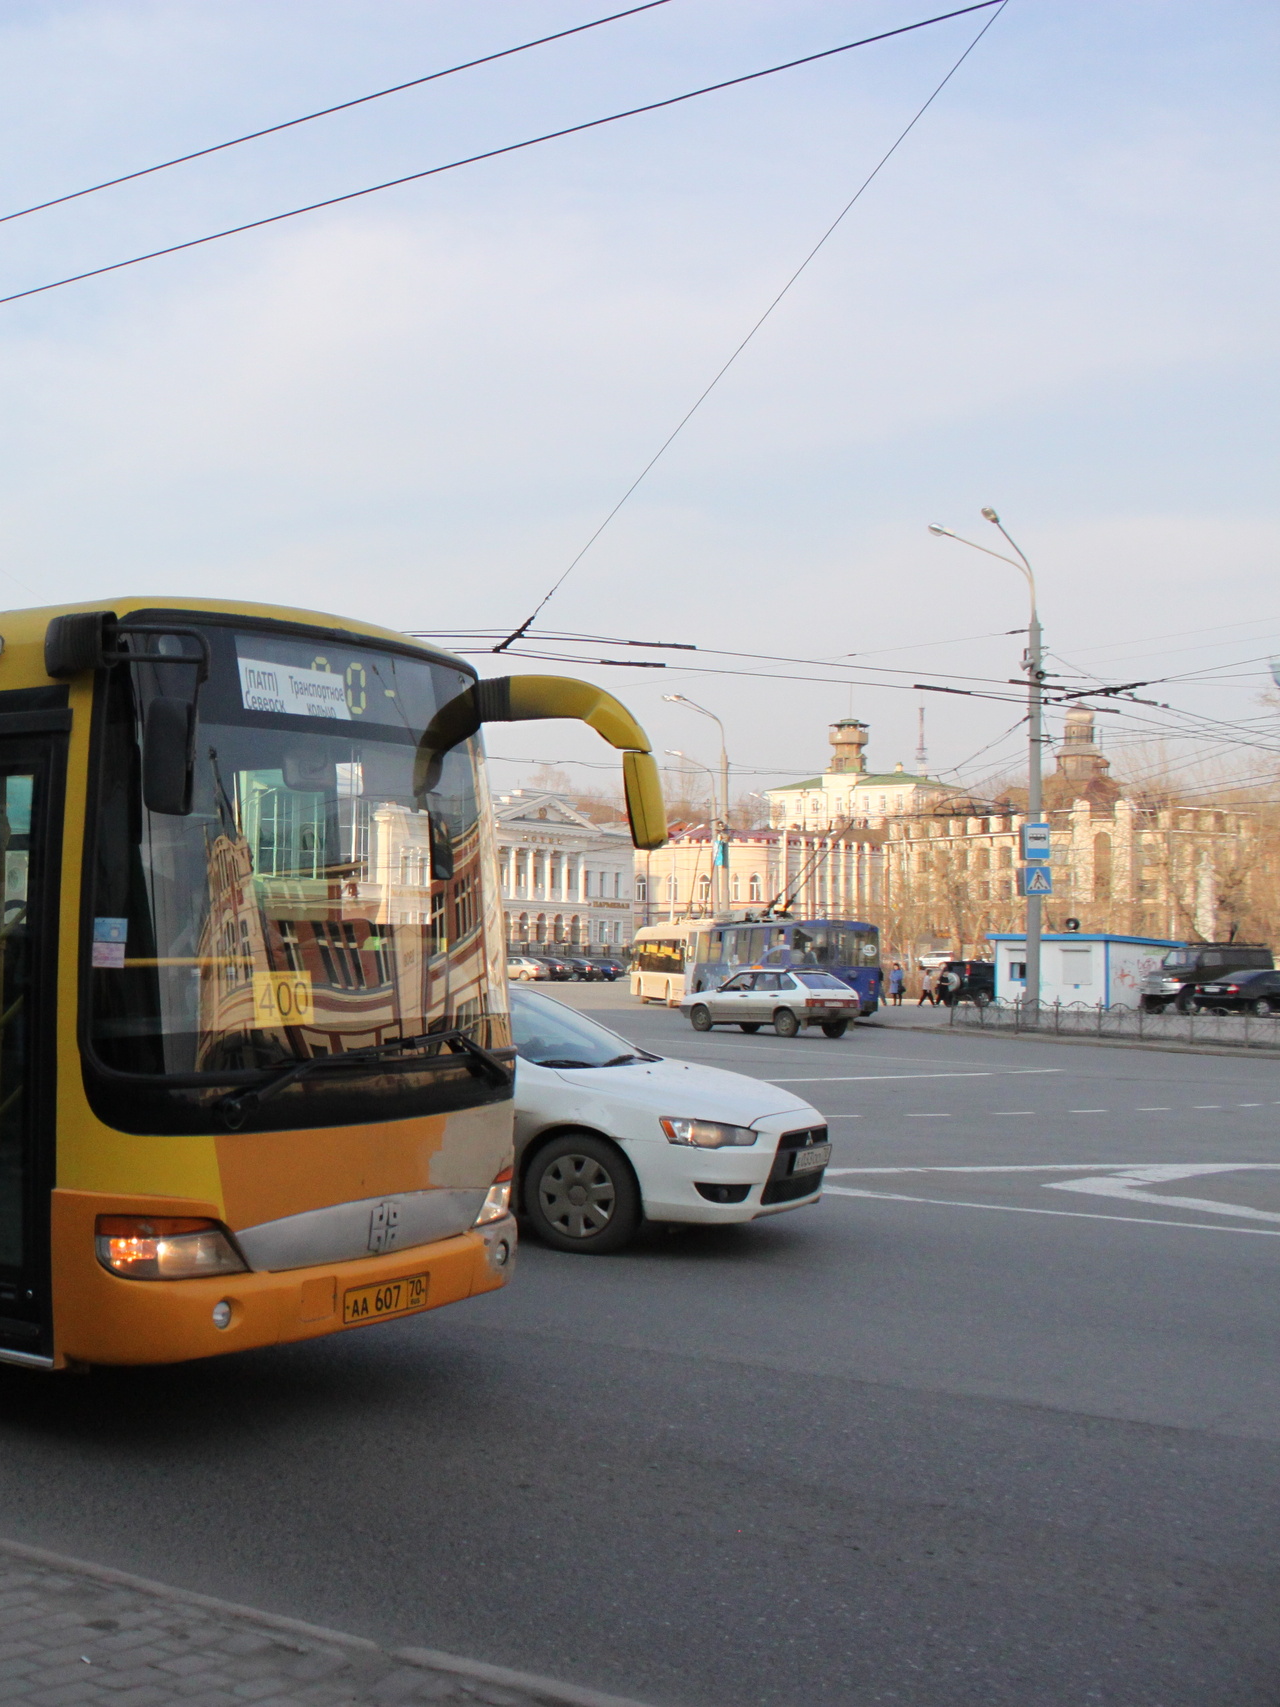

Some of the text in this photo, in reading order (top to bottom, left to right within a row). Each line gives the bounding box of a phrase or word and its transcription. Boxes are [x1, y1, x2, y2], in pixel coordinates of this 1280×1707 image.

[244, 666, 345, 702] (ПАТП) Транспортное
[244, 690, 287, 713] Северск
[258, 981, 309, 1017] 400
[375, 1284, 401, 1312] 607
[409, 1279, 422, 1298] 70
